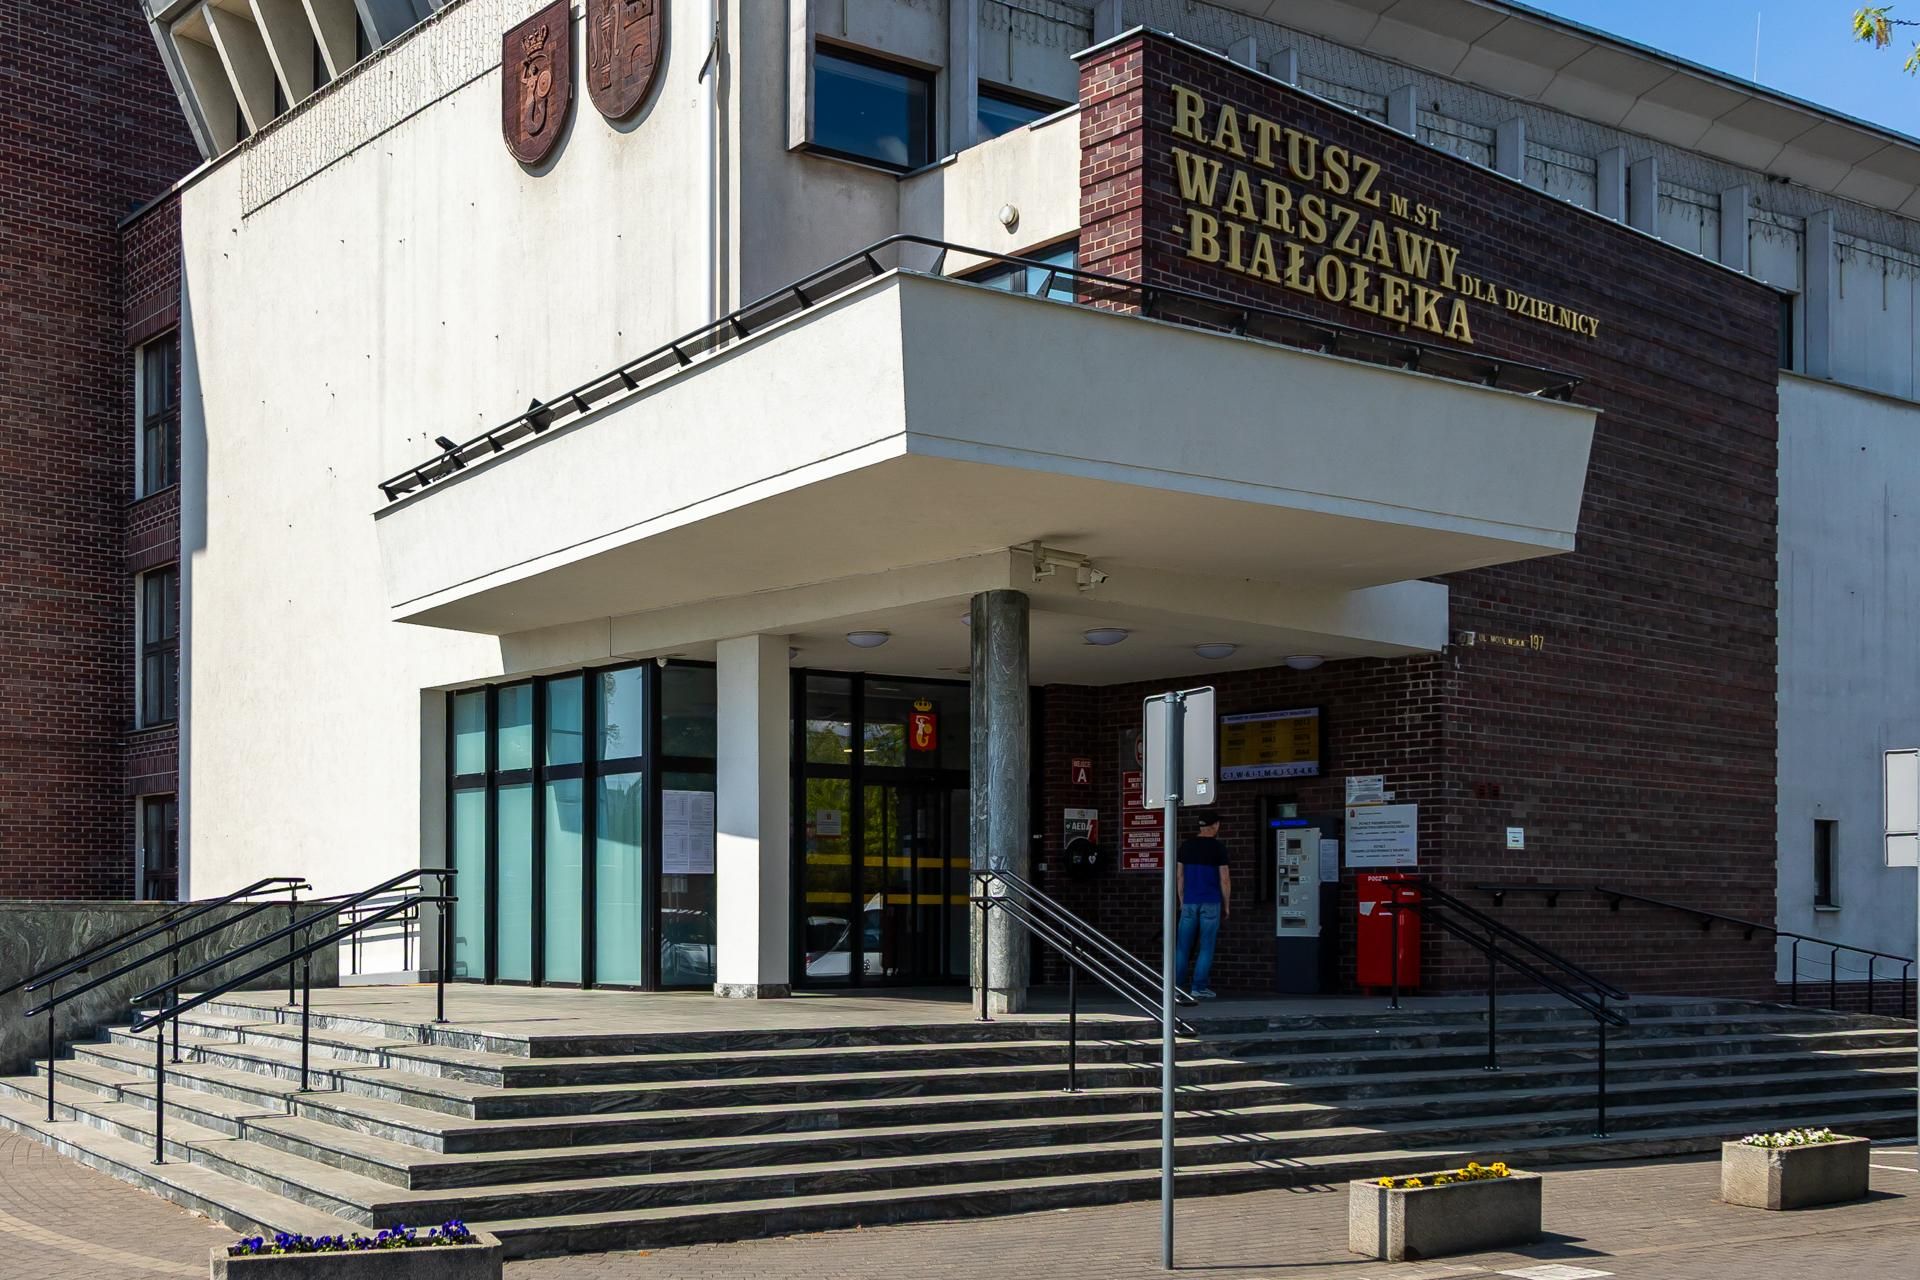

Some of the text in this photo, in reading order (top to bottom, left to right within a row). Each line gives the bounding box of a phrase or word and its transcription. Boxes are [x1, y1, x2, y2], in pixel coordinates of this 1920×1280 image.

[1171, 84, 1381, 207] RATUSZ
[1172, 147, 1600, 337] WARSZAWY DLA DZIELNICY
[1529, 633, 1544, 651] 197
[1077, 767, 1087, 783] A
